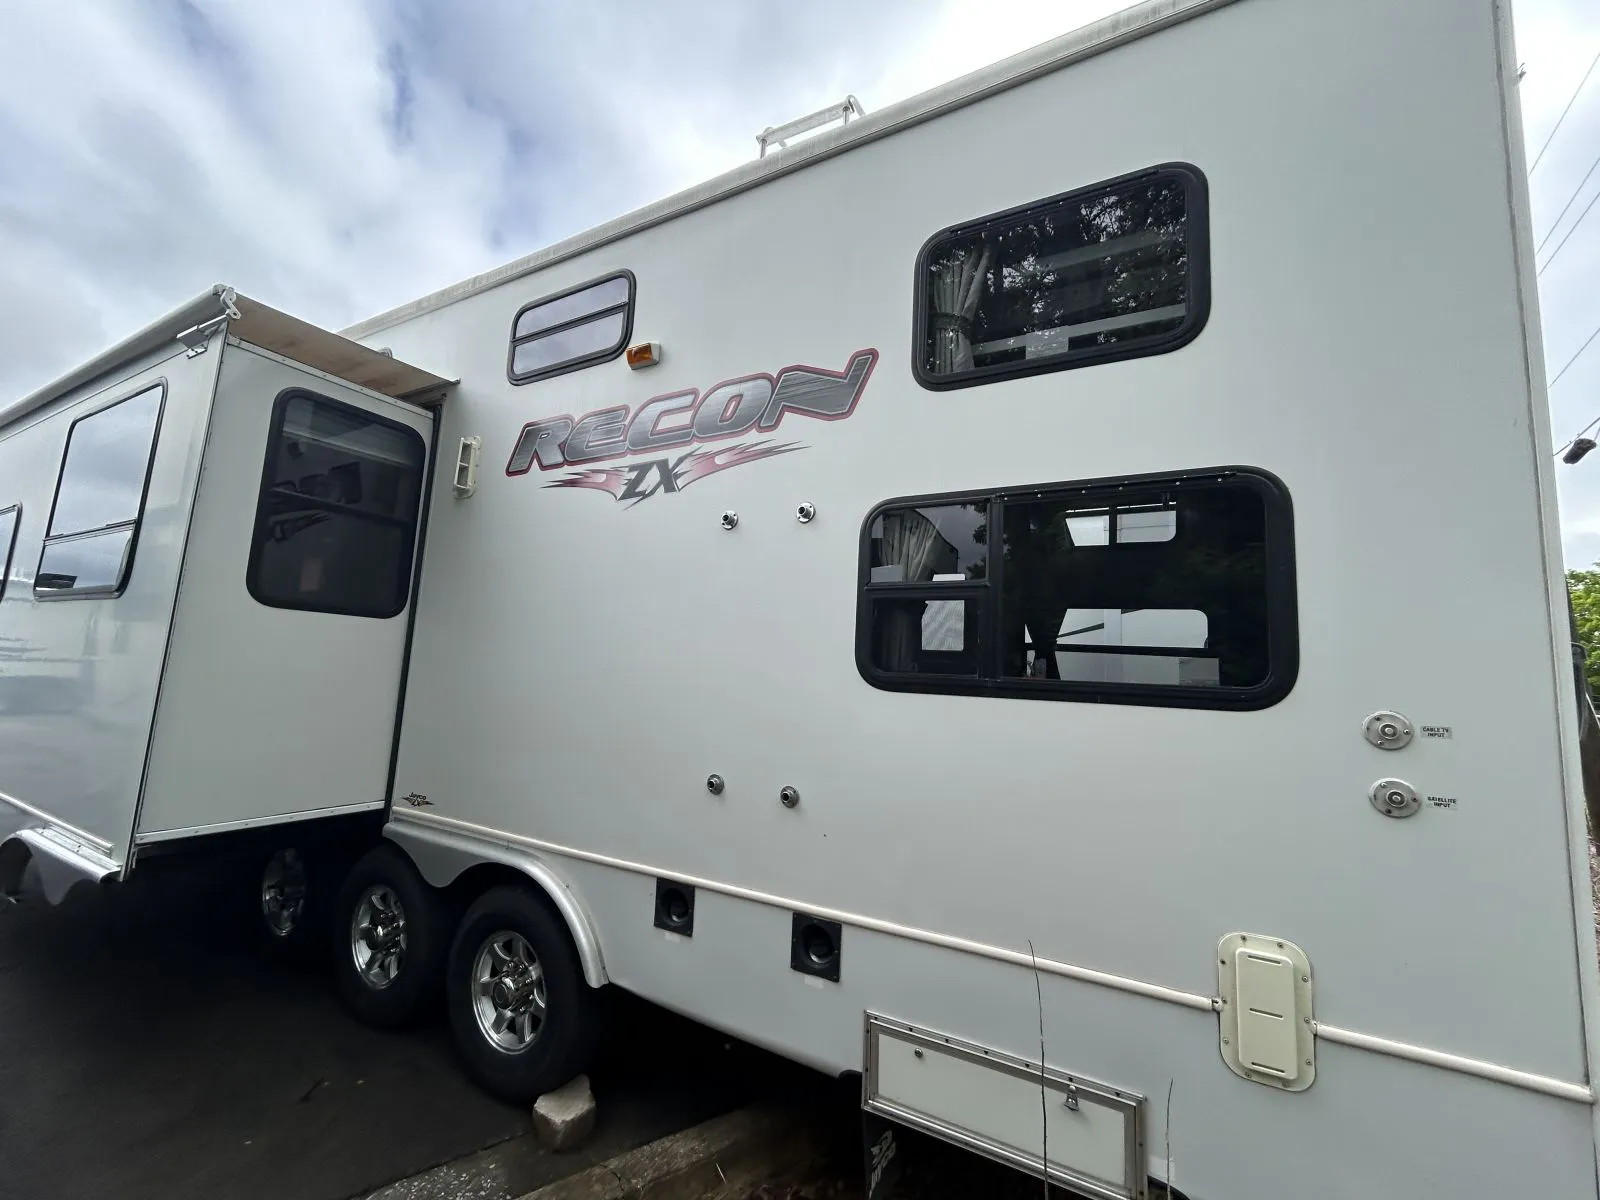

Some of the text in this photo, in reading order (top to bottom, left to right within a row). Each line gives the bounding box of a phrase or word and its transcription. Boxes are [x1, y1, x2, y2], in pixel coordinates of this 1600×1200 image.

[505, 347, 880, 477] RECON
[616, 453, 696, 506] ZX
[1427, 796, 1457, 804] SATELLITE
